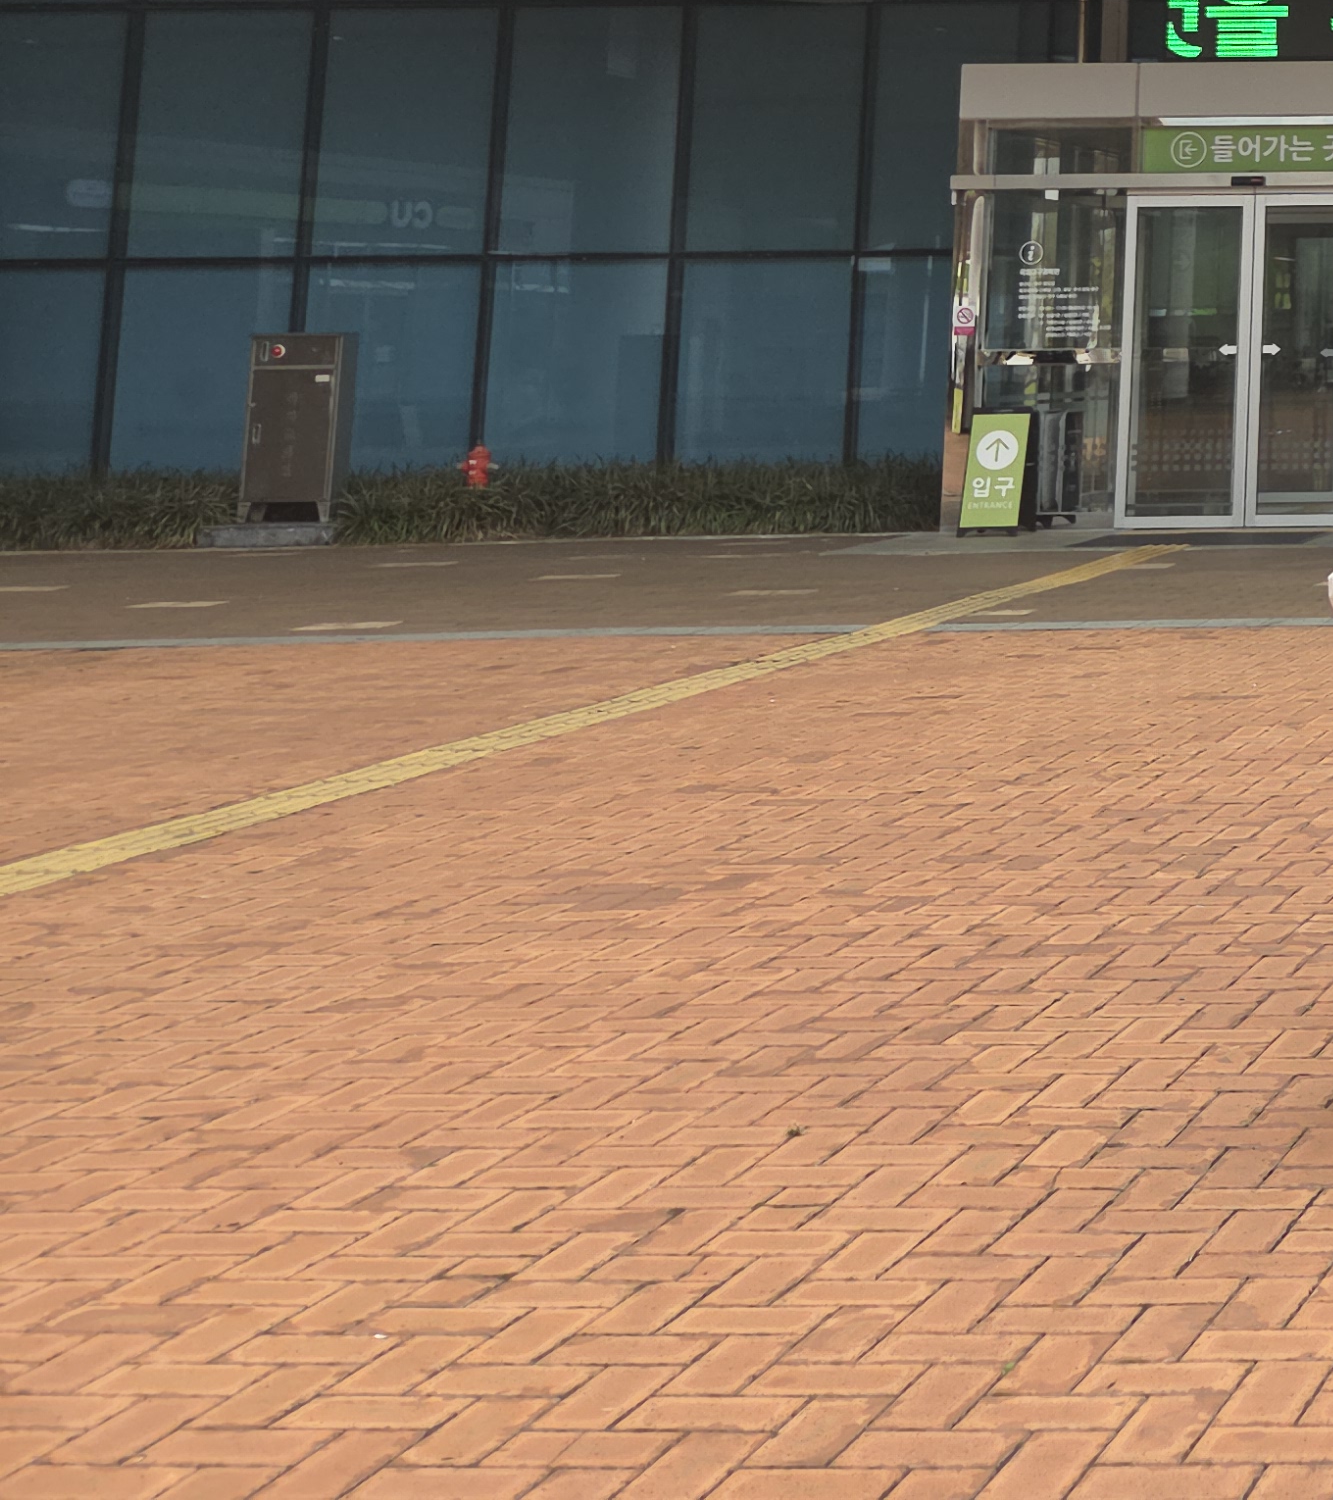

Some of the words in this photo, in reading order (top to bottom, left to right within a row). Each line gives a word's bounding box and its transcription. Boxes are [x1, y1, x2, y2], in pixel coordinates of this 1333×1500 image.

[1210, 134, 1315, 163] 들어가는
[972, 476, 1016, 498] 입구
[967, 501, 1014, 510] ENTRANCE
